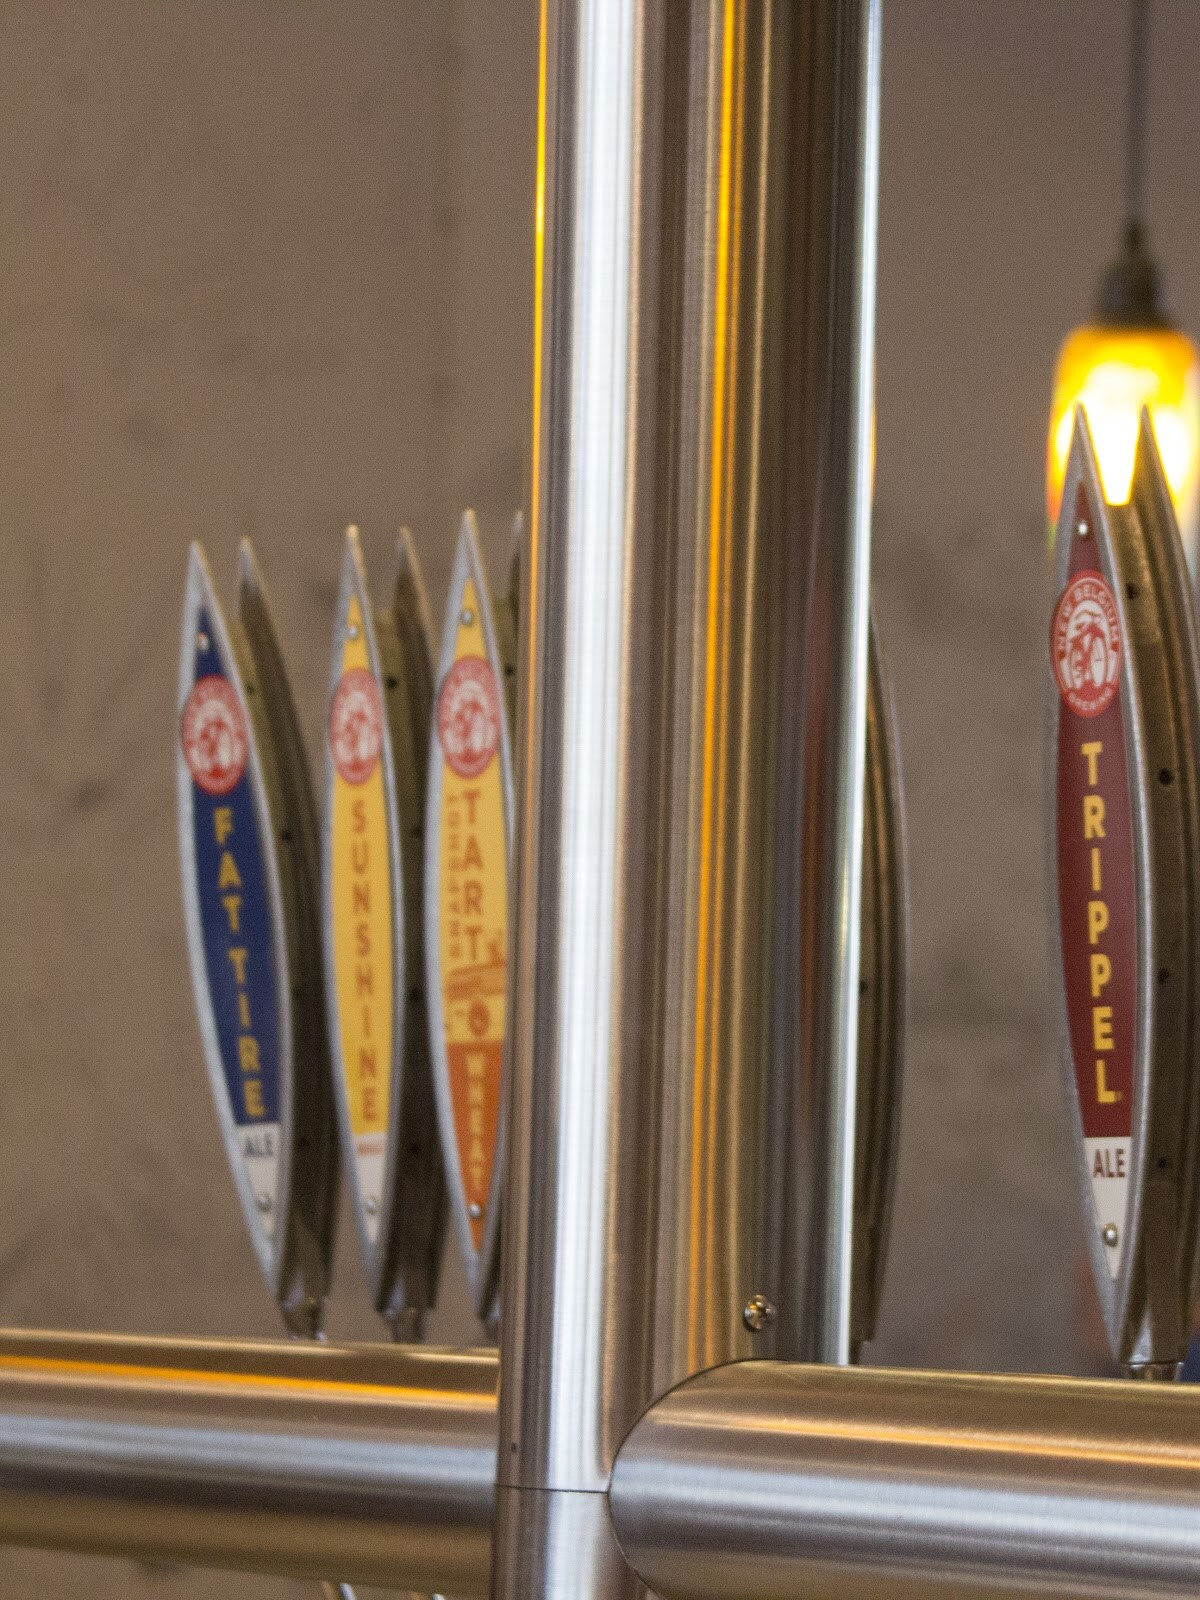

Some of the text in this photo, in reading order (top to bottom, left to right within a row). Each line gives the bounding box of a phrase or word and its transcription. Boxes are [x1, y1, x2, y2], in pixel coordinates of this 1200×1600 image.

[213, 807, 242, 933] FAT
[228, 948, 266, 1117] TIRE
[351, 799, 377, 1123] SUNSHINE
[463, 788, 484, 962] TART
[1081, 741, 1117, 1104] TRIPEL
[244, 1132, 274, 1159] ALE
[1092, 1148, 1126, 1179] ALE
